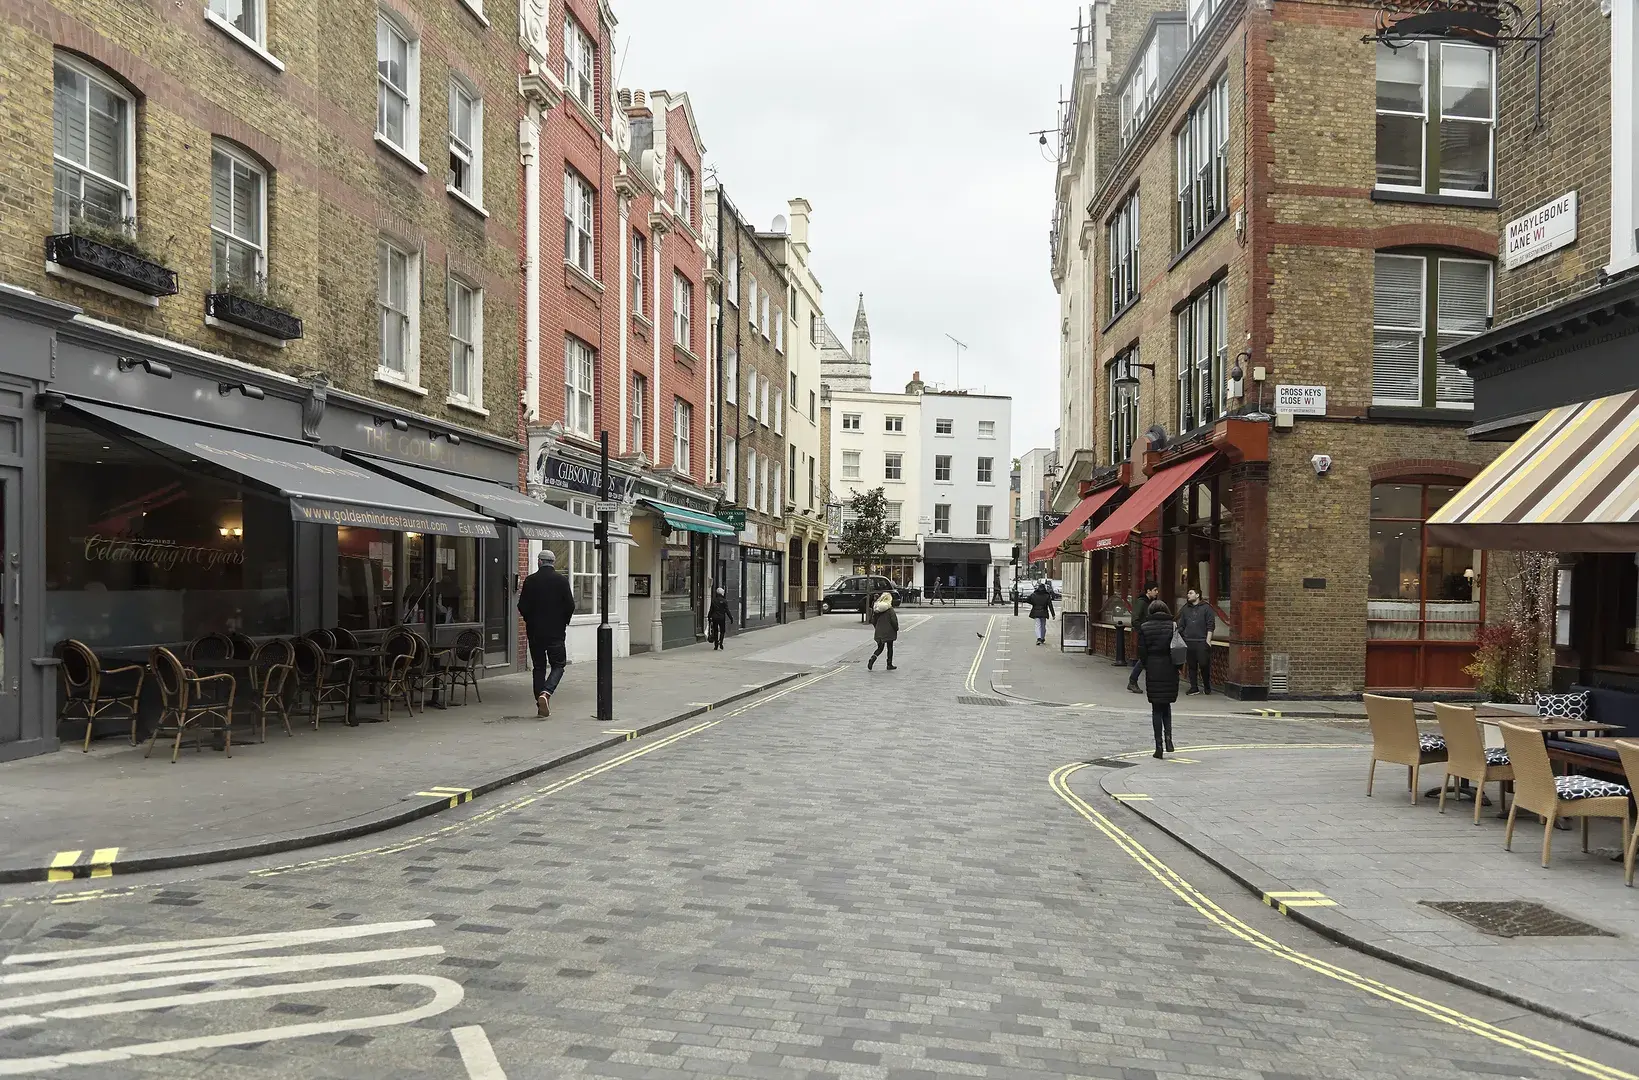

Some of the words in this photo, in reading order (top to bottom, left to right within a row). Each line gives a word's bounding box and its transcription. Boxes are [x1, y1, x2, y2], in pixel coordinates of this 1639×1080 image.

[1510, 199, 1569, 238] MARYLEBONE
[1510, 233, 1531, 253] LANE
[1533, 226, 1545, 241] W1
[1280, 388, 1303, 396] CROSS
[1304, 388, 1322, 397] KEYS
[1280, 396, 1301, 404] CLOSE
[1304, 397, 1316, 405] W1
[363, 426, 393, 453] THE
[558, 462, 591, 486] GIBSON
[302, 506, 448, 532] www.goldenhindrestaurant.com
[458, 523, 474, 534] Est.
[474, 524, 491, 535] 1914
[84, 533, 177, 571] Celebrating
[203, 549, 247, 571] years
